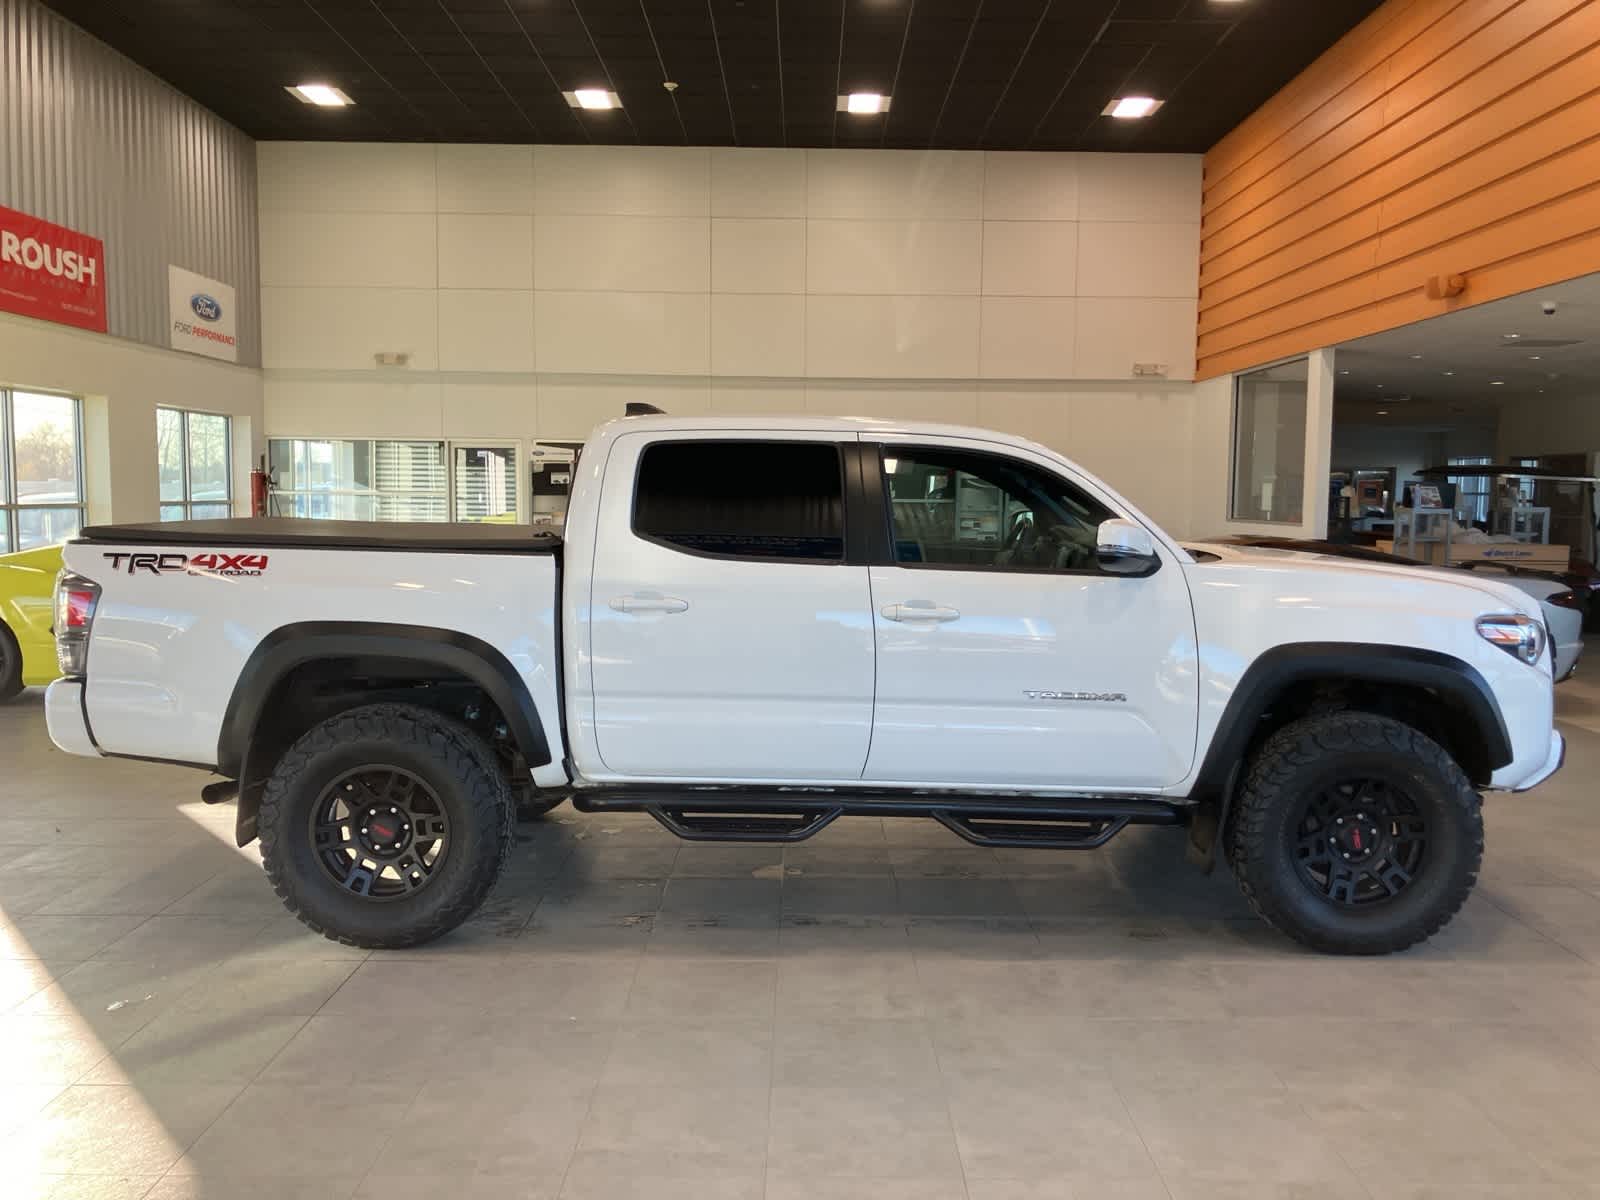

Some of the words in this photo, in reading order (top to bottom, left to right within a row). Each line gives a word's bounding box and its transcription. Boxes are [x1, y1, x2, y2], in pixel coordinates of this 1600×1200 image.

[1, 230, 96, 287] ROUSH
[196, 298, 216, 318] Ford
[174, 321, 192, 336] FORD
[103, 552, 188, 576] TRD
[1022, 690, 1127, 702] TACOMA
